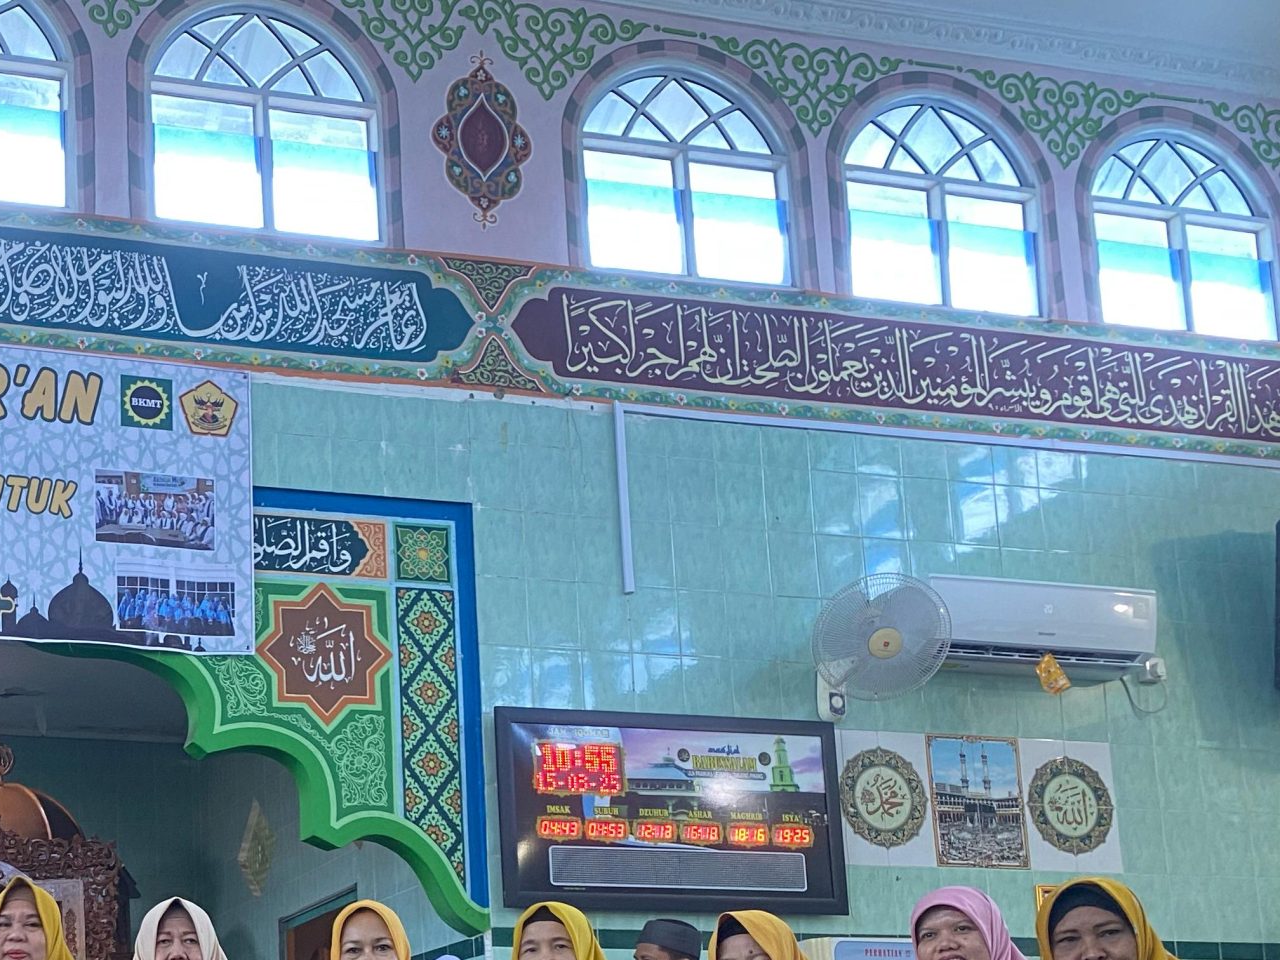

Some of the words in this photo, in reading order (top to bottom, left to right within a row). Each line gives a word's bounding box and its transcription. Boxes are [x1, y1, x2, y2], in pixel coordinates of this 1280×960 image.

[131, 397, 162, 409] BKMT
[542, 744, 617, 773] 10:55
[535, 771, 620, 794] 15-03-25
[547, 805, 571, 813] IMSAK
[541, 821, 578, 834] 04:43
[588, 823, 625, 837] 04:53
